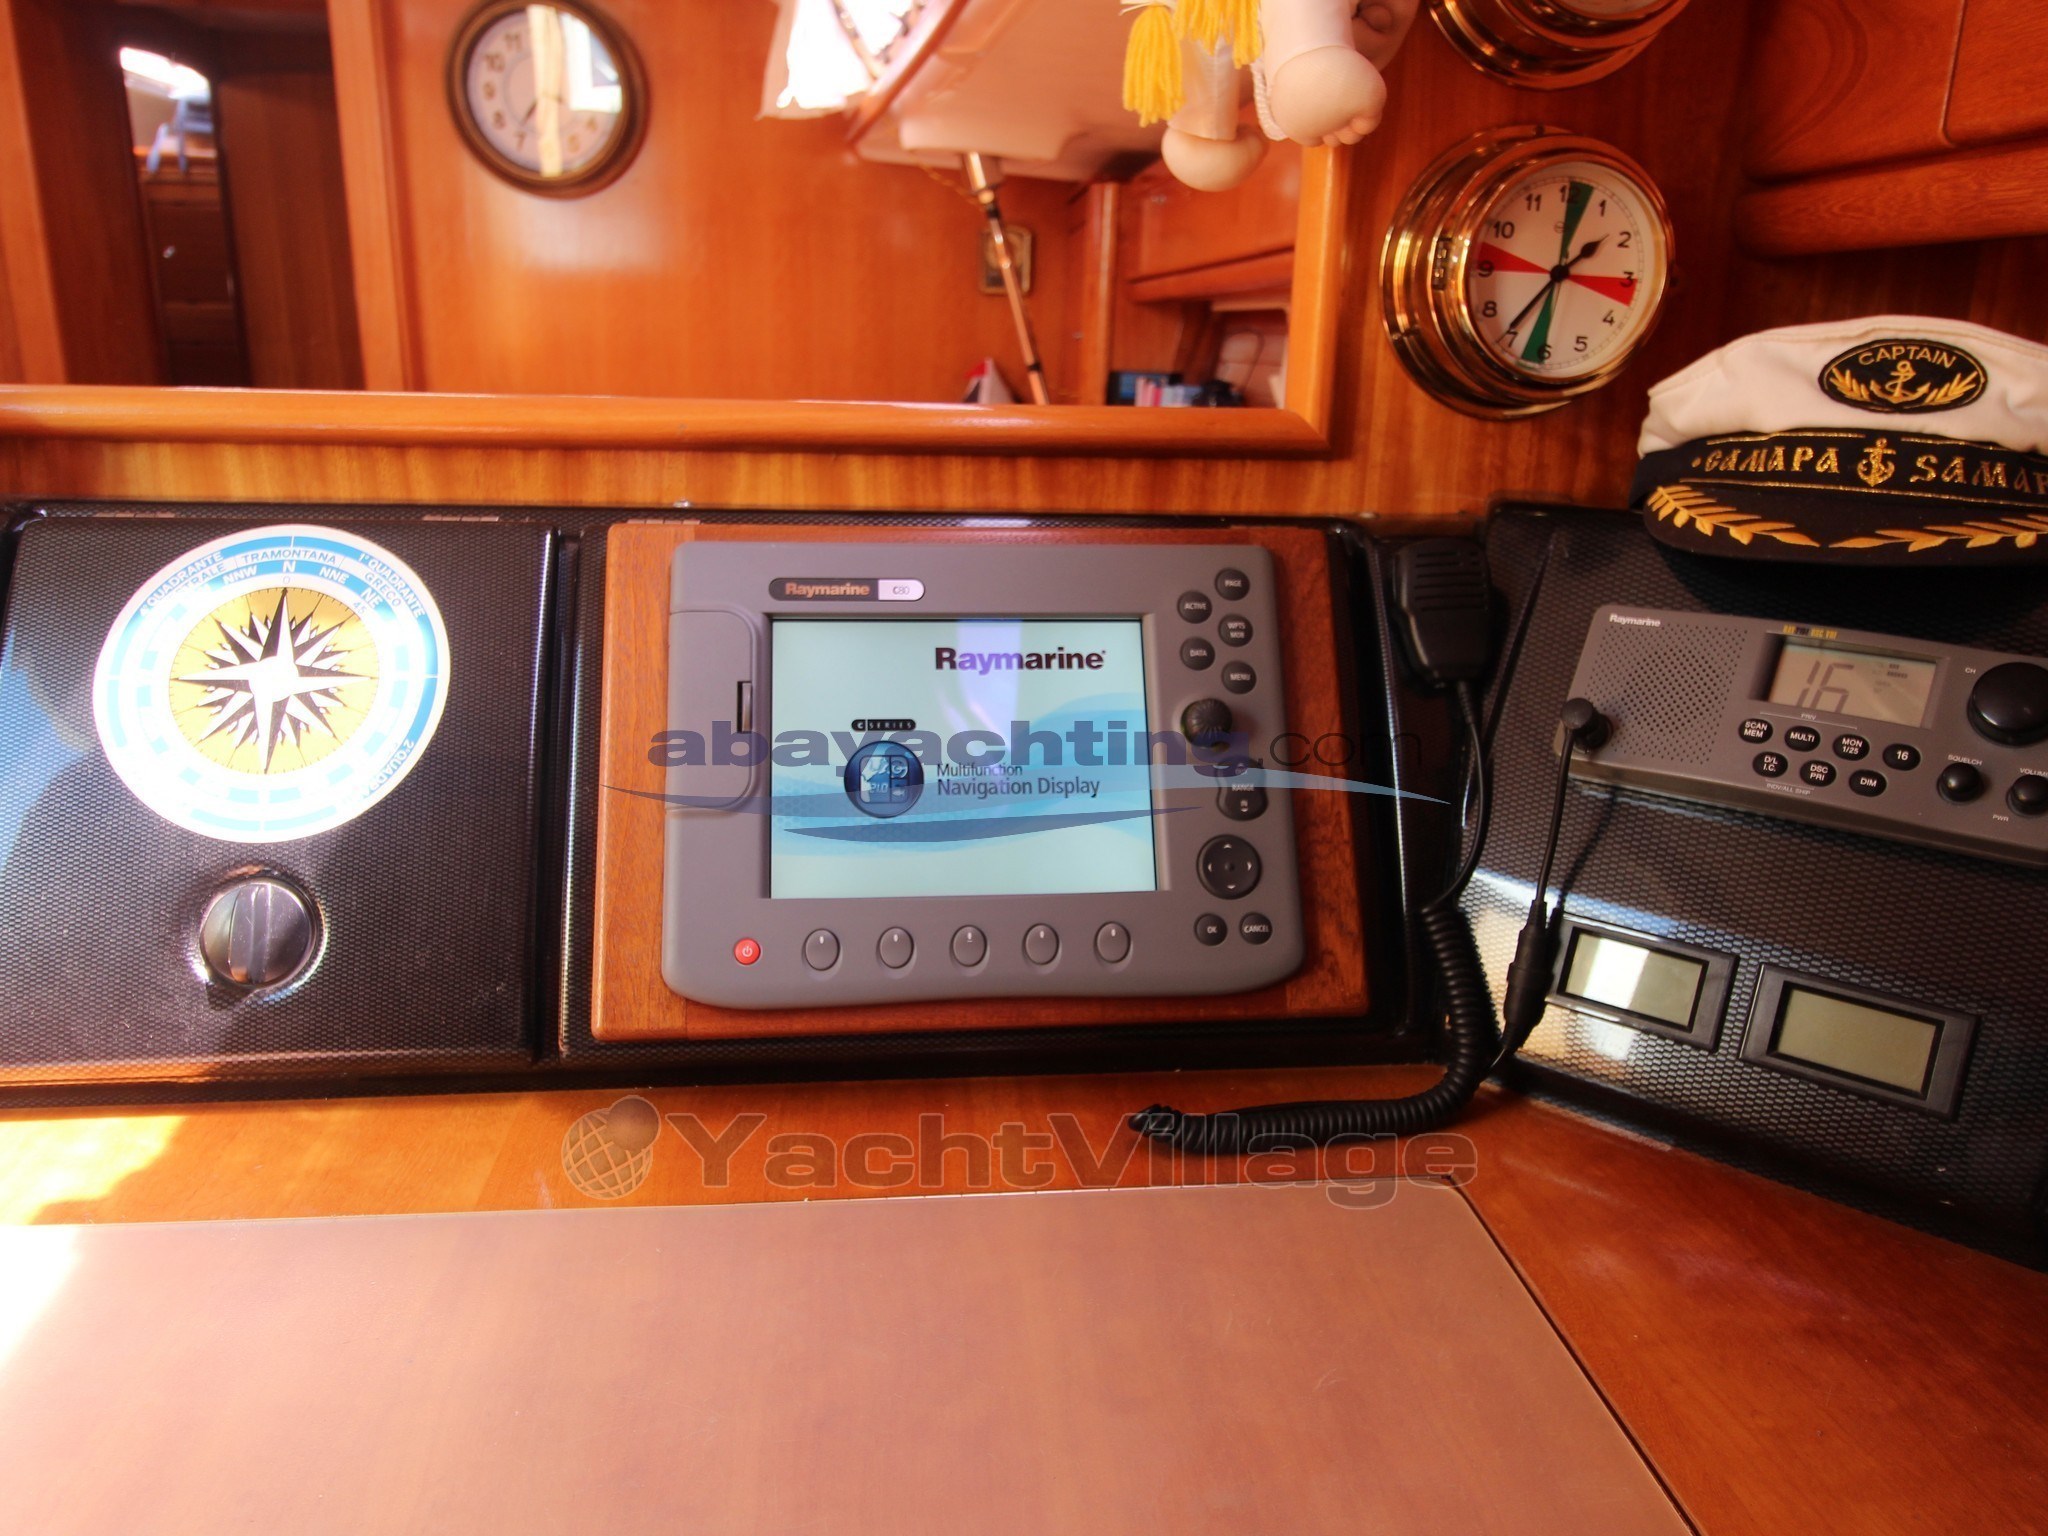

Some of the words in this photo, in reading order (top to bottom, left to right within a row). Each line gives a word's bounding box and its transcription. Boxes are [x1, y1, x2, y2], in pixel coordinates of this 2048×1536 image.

[1559, 184, 1582, 204] 12
[1525, 193, 1542, 212] 11
[1598, 199, 1608, 218] 1
[1493, 221, 1515, 240] 10
[1617, 231, 1632, 249] 2
[1477, 260, 1495, 278] 9
[1619, 270, 1635, 287] 3
[1482, 300, 1498, 318] 8
[1602, 309, 1616, 327] 4
[1506, 328, 1519, 348] 7
[1574, 335, 1589, 353] 5
[1537, 343, 1553, 361] 6
[1857, 344, 1957, 369] CAPTAIN
[241, 549, 337, 565] TRAMONTANA
[221, 564, 258, 584] NNW
[282, 560, 297, 574] N
[319, 566, 349, 585] NNE
[364, 571, 401, 608] GRECO
[368, 558, 426, 619] QUADRANTE
[785, 582, 870, 598] Raymarine
[361, 587, 384, 610] NE
[1183, 602, 1207, 610] ACTIVE
[1608, 612, 1661, 628] Raymarine
[935, 646, 1105, 675] Raymarine
[1189, 649, 1207, 657] DATA
[1964, 667, 1977, 675] CH
[1796, 659, 1855, 714] 16
[869, 721, 912, 729] SERIES
[1743, 728, 1764, 738] MEM
[1744, 720, 1768, 732] SCAN
[1789, 731, 1816, 743] MULTI
[1841, 737, 1863, 748] MON
[1842, 745, 1860, 755] 1/25
[1896, 750, 1909, 761] 16
[1763, 754, 1779, 765] D/L
[1947, 753, 1983, 767] SQUELCH
[936, 762, 1023, 777] Multifunction
[1809, 763, 1829, 775] DSC
[1809, 771, 1826, 782] PRI
[937, 778, 1033, 799] Navigation
[1037, 777, 1101, 798] Display
[1859, 776, 1878, 788] DIM
[1992, 813, 2009, 823] PWR
[1206, 924, 1218, 933] OK
[1243, 924, 1270, 934] CANCEL
